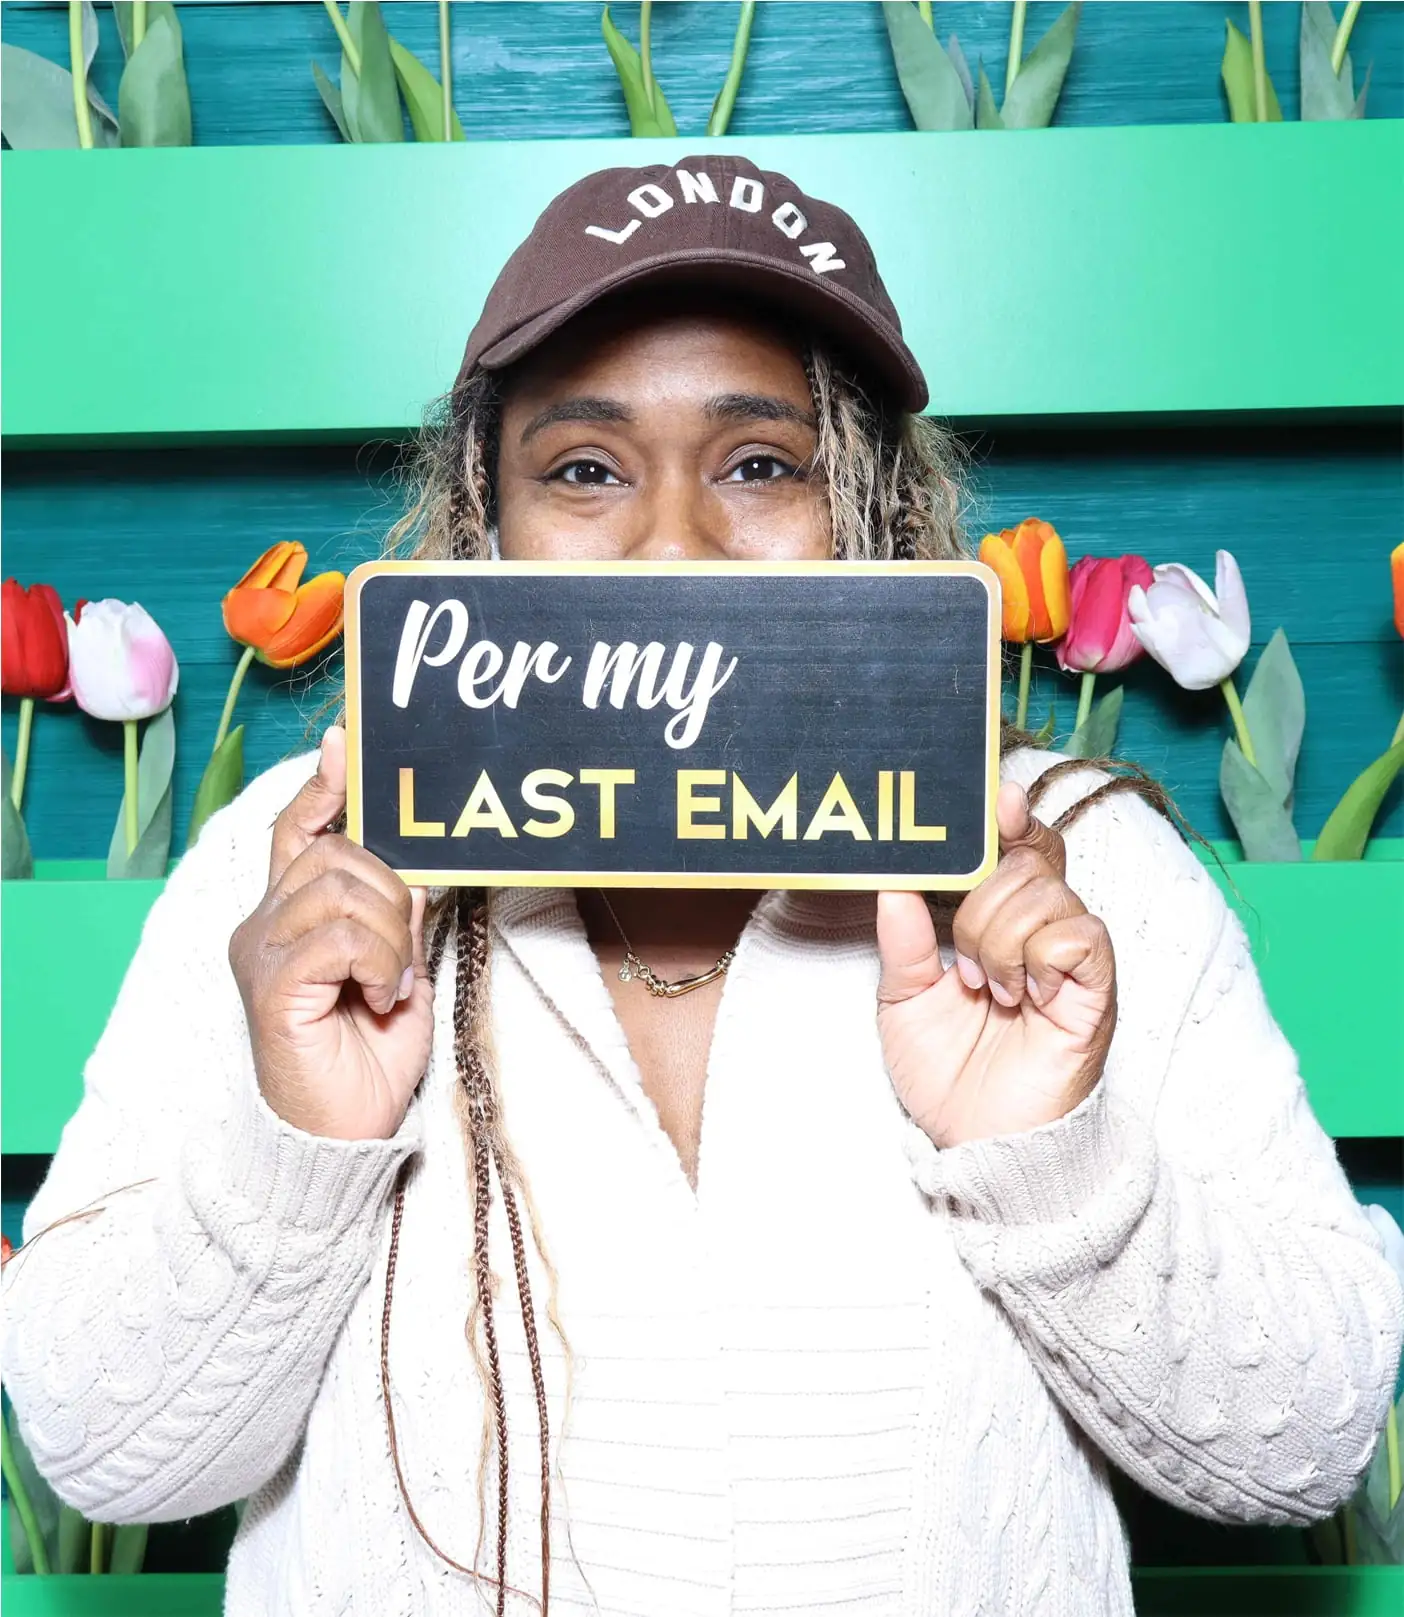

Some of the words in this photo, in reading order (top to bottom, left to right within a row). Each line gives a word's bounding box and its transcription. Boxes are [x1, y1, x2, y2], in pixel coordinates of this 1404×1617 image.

[584, 169, 846, 275] LONDON
[392, 598, 572, 709] Per
[582, 640, 739, 750] my
[398, 767, 636, 839] LAST
[675, 769, 947, 842] EMAIL
